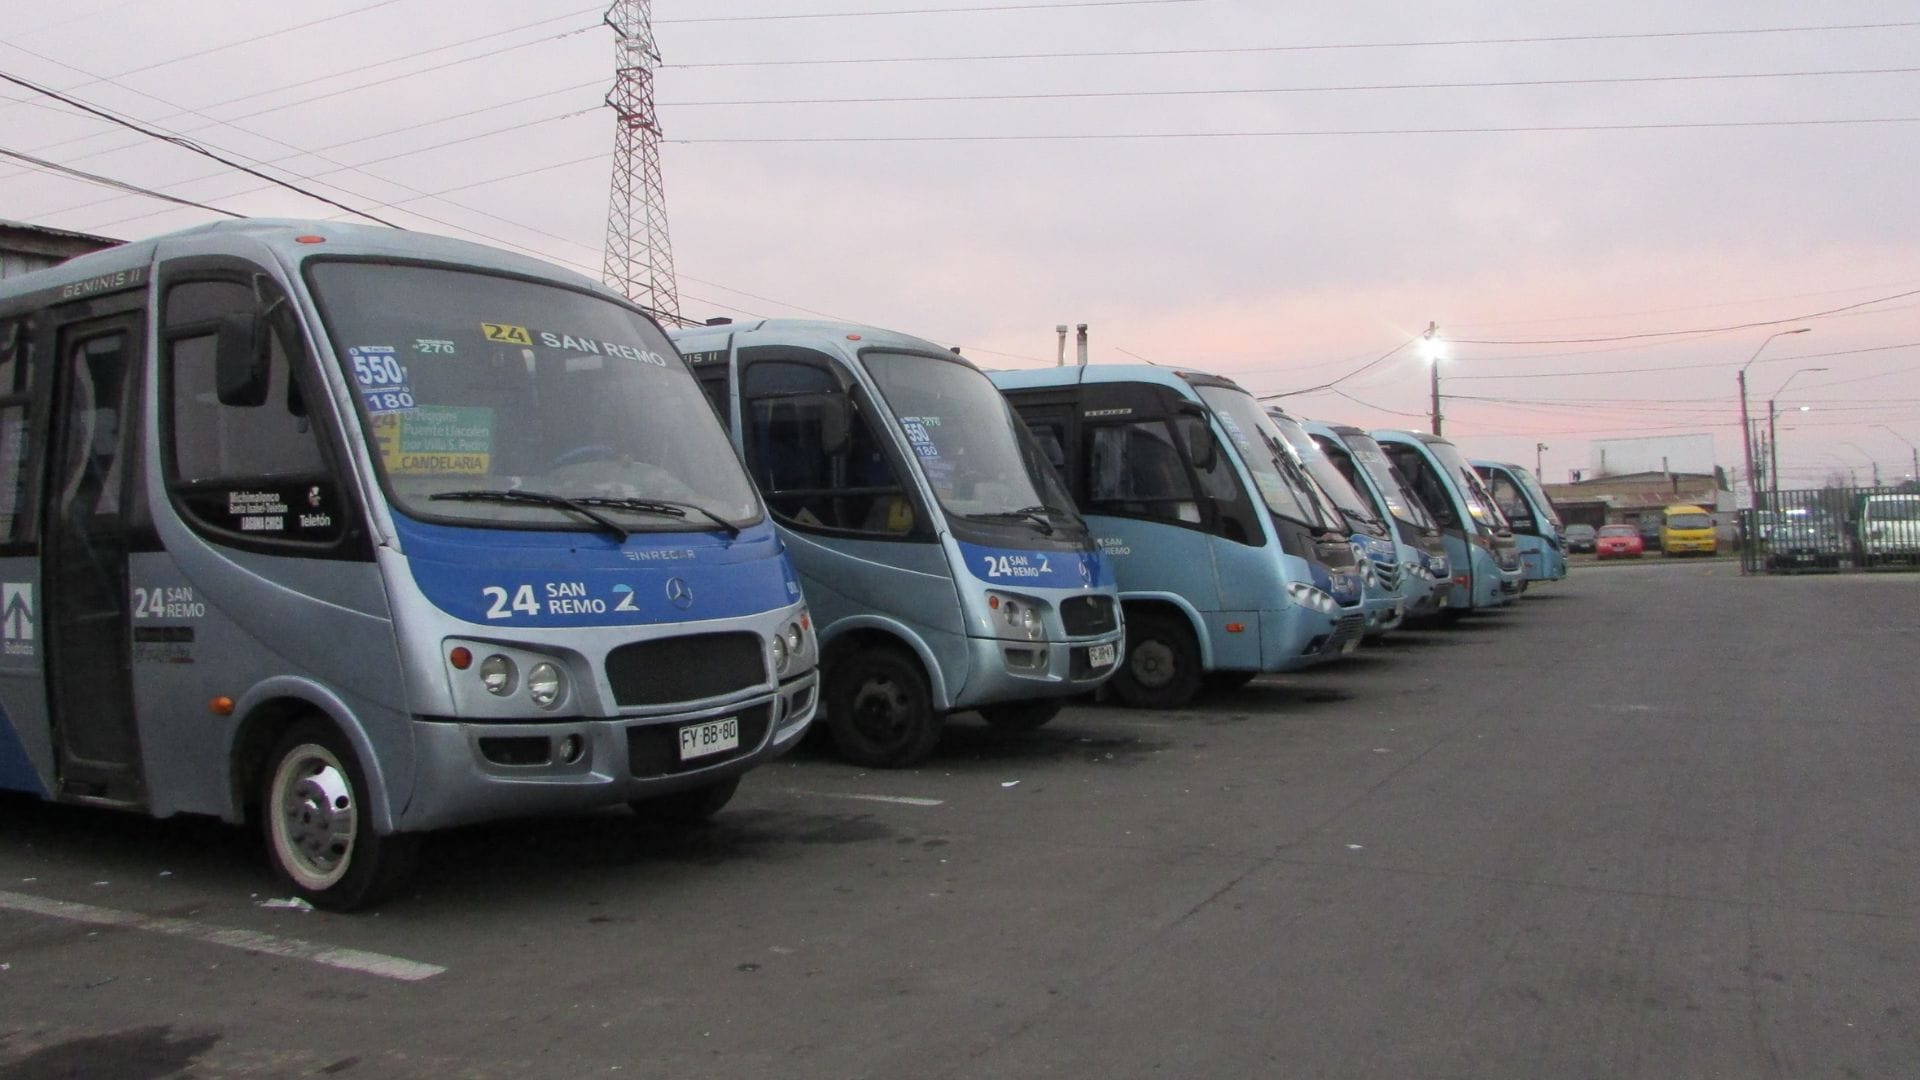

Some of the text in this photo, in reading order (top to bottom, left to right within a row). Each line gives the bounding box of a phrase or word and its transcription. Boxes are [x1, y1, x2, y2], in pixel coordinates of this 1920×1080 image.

[63, 273, 126, 298] GEMINIS
[485, 324, 527, 343] 24
[540, 332, 600, 354] SAN
[602, 342, 667, 368] REMO
[353, 355, 402, 385] 550
[369, 392, 414, 409] 180
[903, 423, 930, 442] 550
[917, 446, 938, 456] 180
[401, 455, 482, 470] CANDELARIA
[299, 512, 331, 527] Teletón
[1104, 537, 1122, 546] SAN
[984, 556, 1028, 577] 24 SAN
[1012, 566, 1039, 577] REMO
[135, 586, 193, 618] 24 SAN
[482, 582, 587, 619] 24 SAN
[549, 599, 606, 615] REMO
[167, 603, 205, 618] REMO
[681, 728, 698, 750] FY
